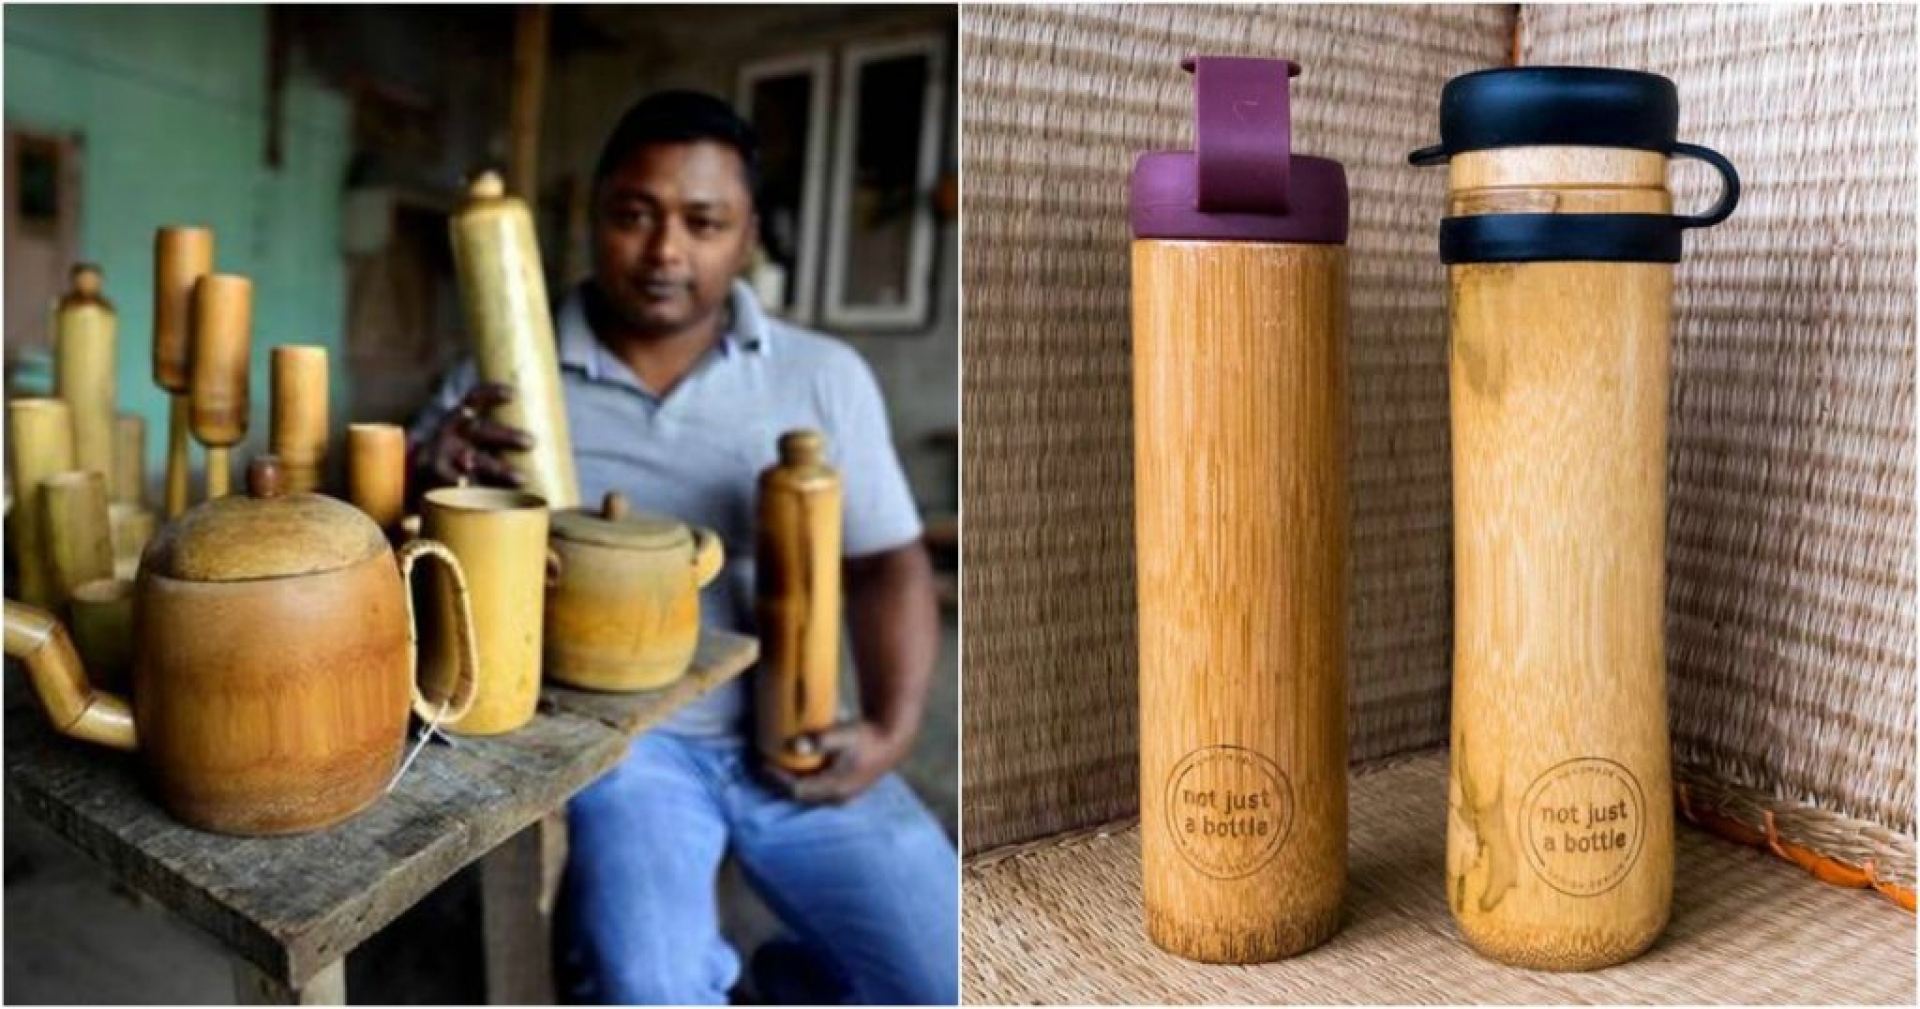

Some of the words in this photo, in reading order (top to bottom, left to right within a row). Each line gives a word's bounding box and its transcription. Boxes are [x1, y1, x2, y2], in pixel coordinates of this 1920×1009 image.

[1183, 789, 1217, 809] not
[1224, 788, 1271, 815] just
[1541, 802, 1579, 824] not
[1586, 799, 1628, 829] just
[1184, 817, 1195, 833] a
[1203, 815, 1268, 838] bottle
[1543, 835, 1556, 852] a
[1564, 827, 1627, 853] bottle
